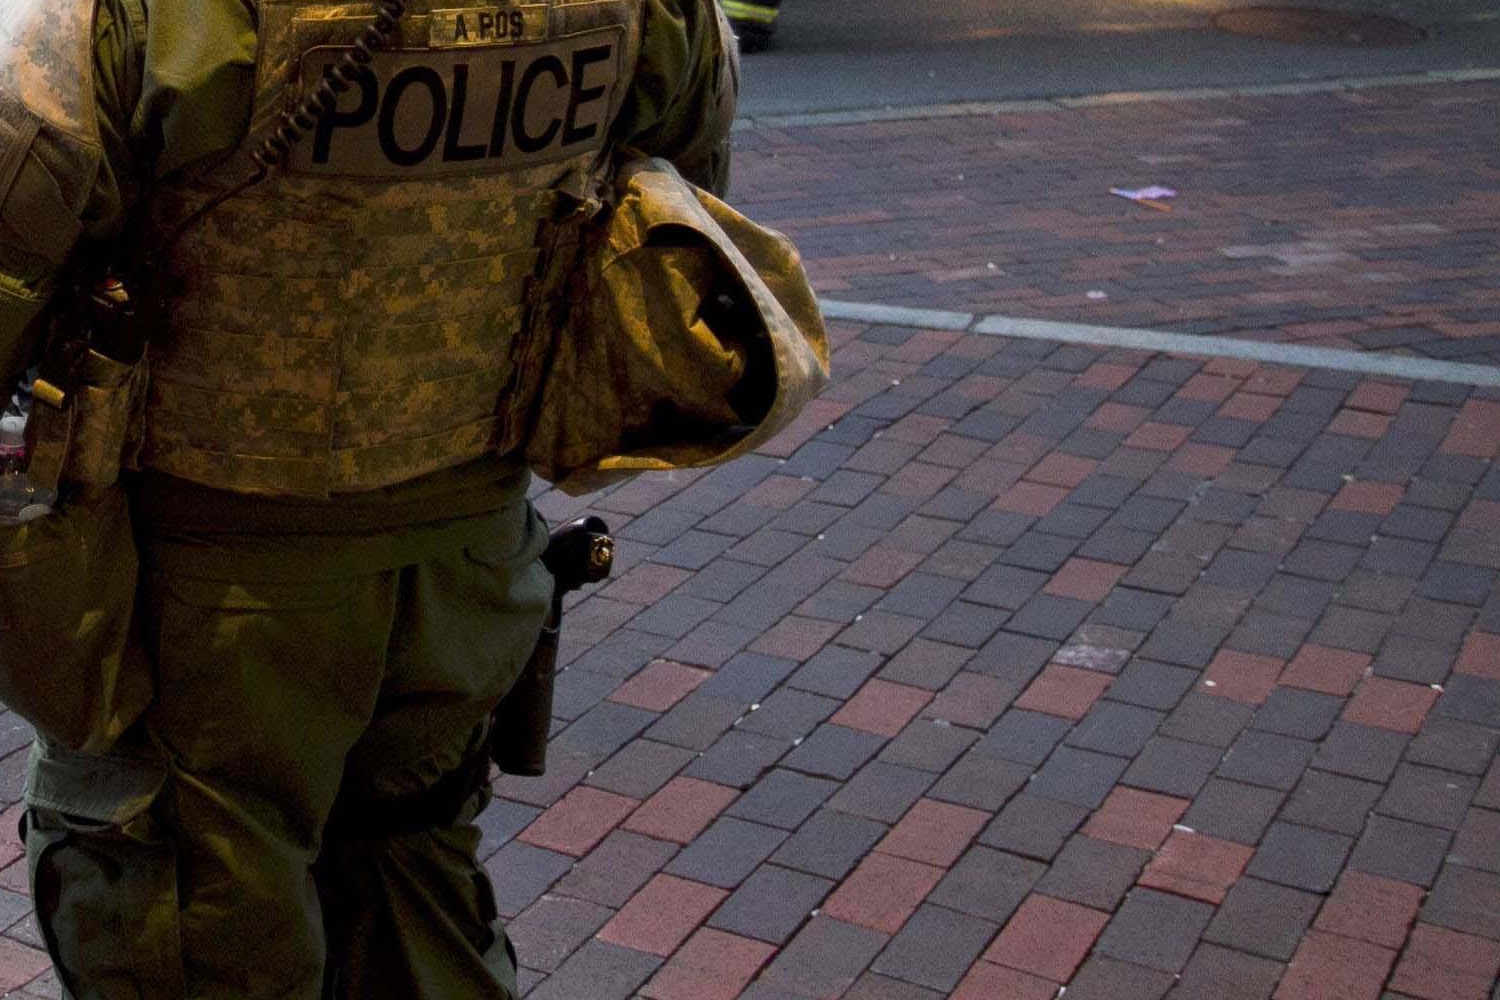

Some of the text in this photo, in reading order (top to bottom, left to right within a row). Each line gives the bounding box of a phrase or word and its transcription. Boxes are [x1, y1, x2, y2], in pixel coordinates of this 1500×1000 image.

[454, 11, 524, 41] A POS
[311, 43, 612, 167] POLICE
